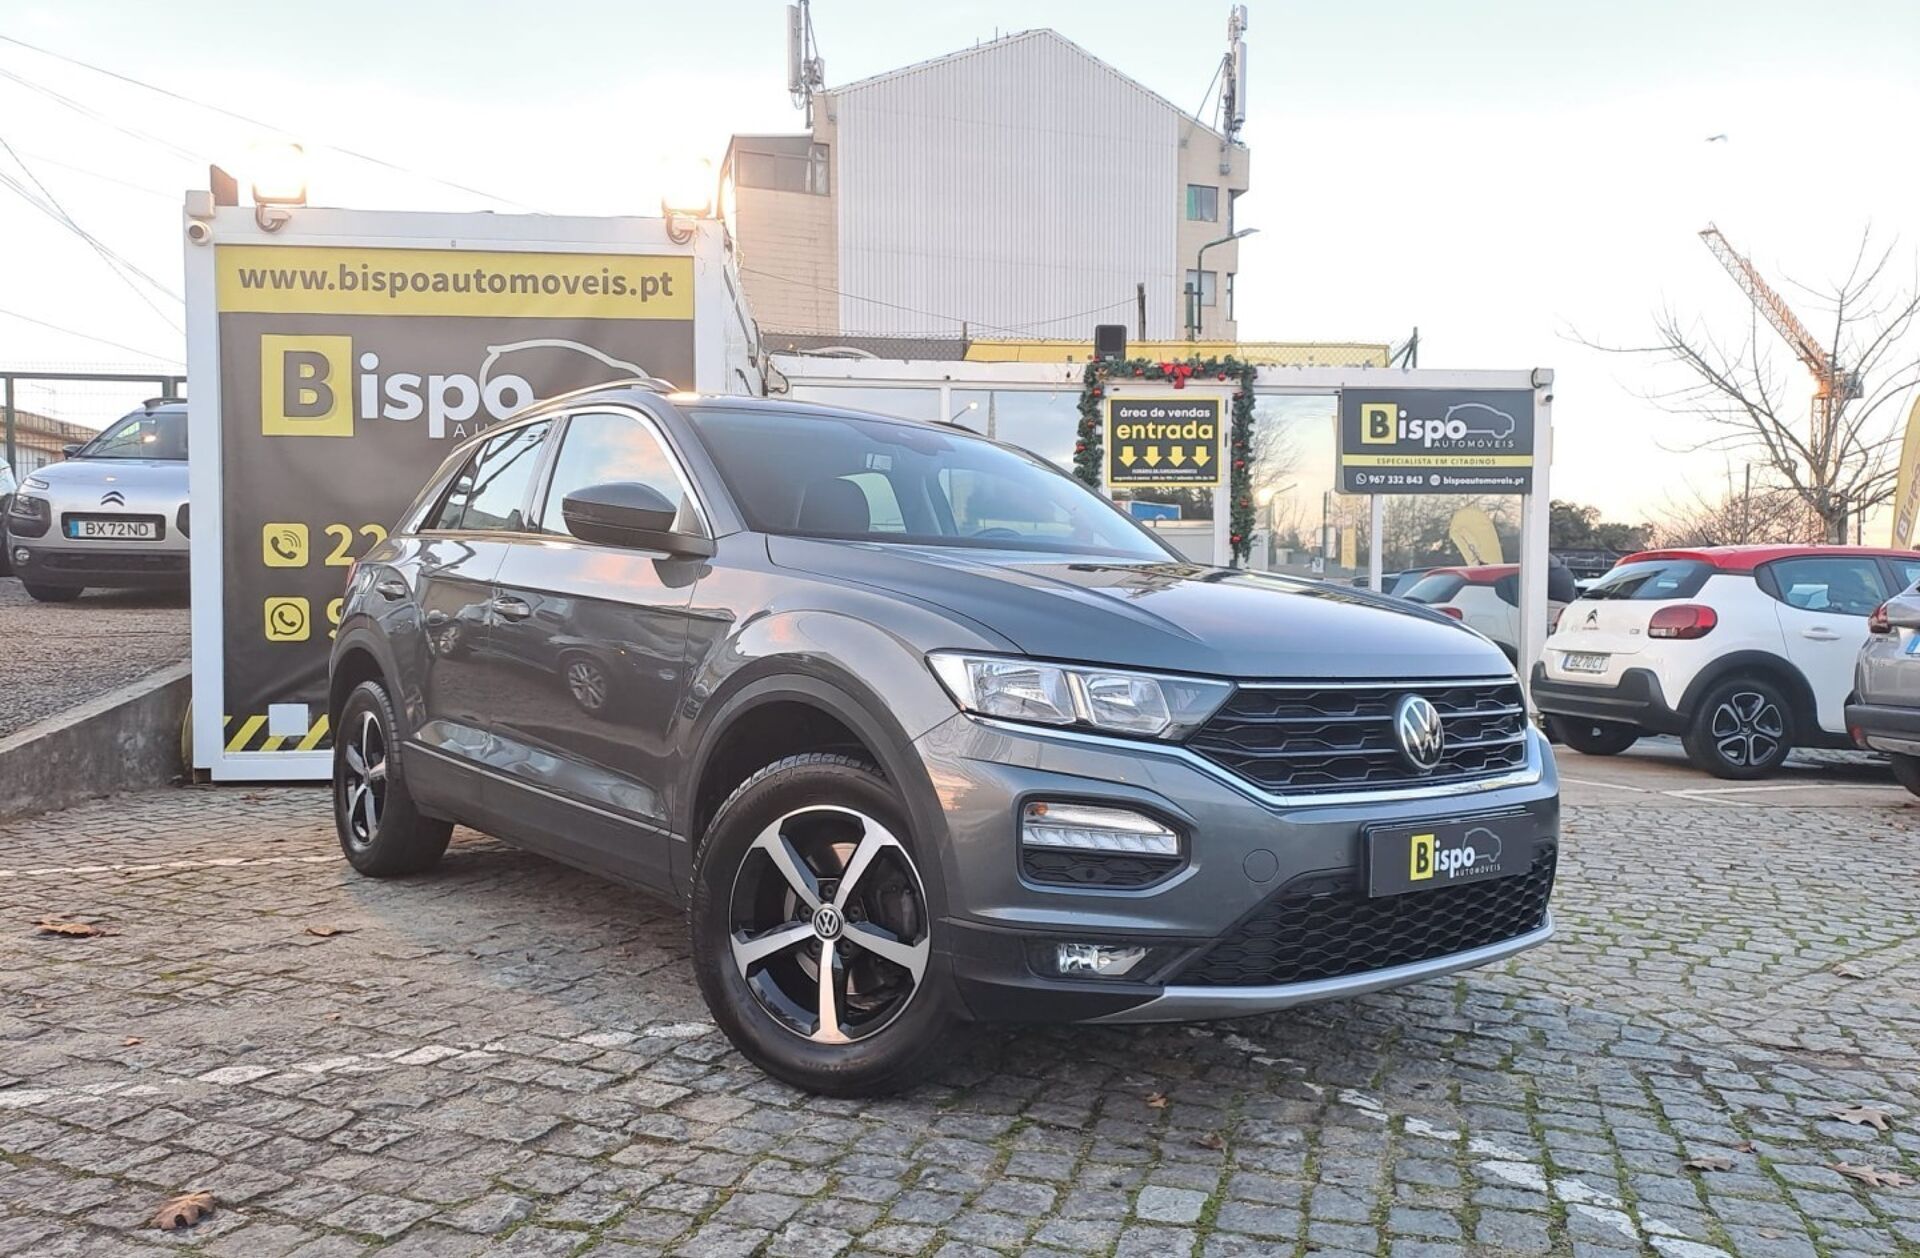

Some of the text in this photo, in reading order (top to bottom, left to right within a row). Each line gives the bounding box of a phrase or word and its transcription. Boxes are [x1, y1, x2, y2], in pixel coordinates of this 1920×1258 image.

[239, 264, 674, 299] www.bispoautomoveis.pt
[283, 351, 534, 440] Bispo
[1119, 406, 1211, 418] área de vendas
[1116, 420, 1213, 440] entrada
[1369, 409, 1468, 448] Bispo
[1433, 438, 1515, 449] AUTOMÓVEIS
[1376, 457, 1496, 466] ESPECIALISTA EM CITADINOS
[1368, 475, 1385, 485] 967
[1387, 475, 1404, 485] 332
[1415, 838, 1475, 879] Bispo
